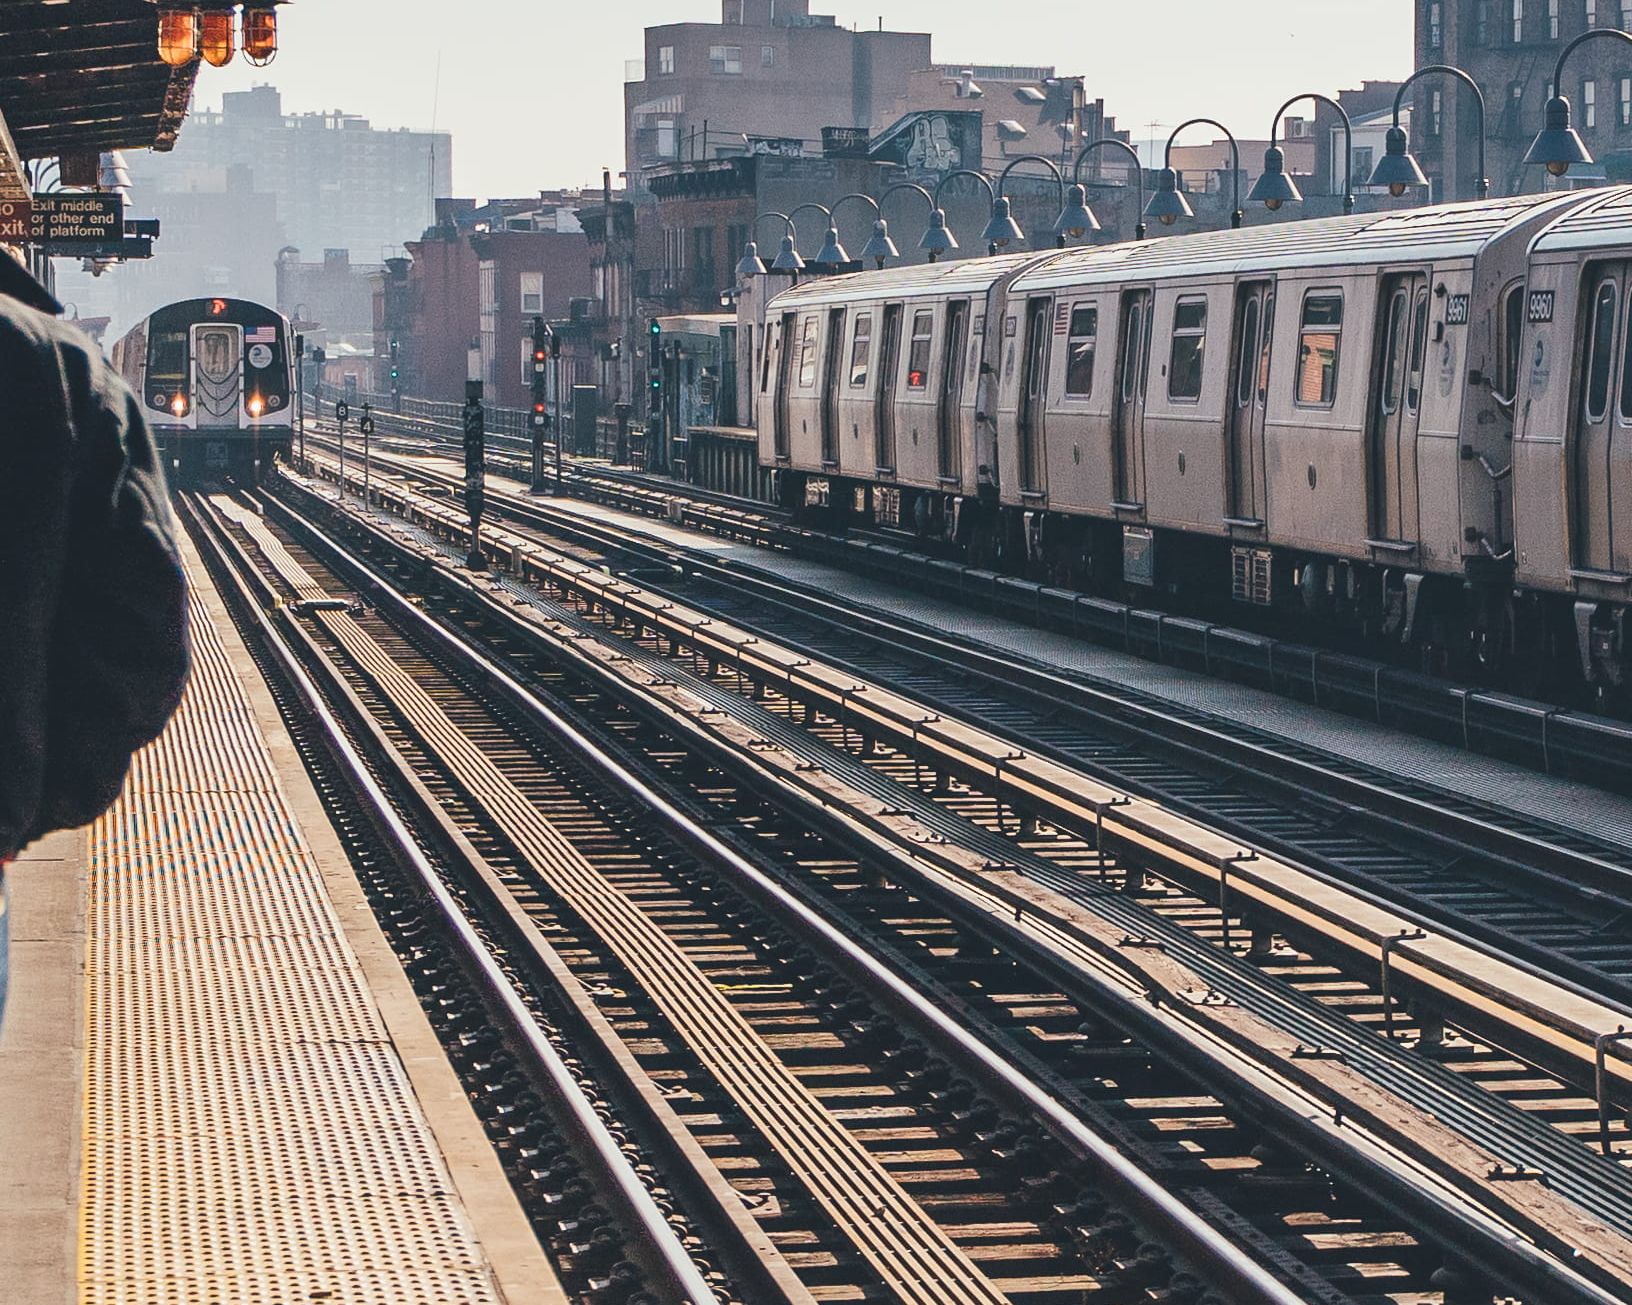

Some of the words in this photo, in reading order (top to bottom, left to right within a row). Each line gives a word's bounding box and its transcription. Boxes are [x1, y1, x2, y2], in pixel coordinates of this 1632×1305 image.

[31, 200, 56, 211] Exit
[61, 201, 104, 211] middle
[31, 215, 44, 224] or
[50, 213, 84, 224] other
[89, 213, 114, 224] end
[31, 225, 44, 236] of
[50, 225, 105, 238] platform
[1530, 293, 1553, 319] 9960
[338, 406, 346, 416] 8
[363, 421, 371, 432] 4
